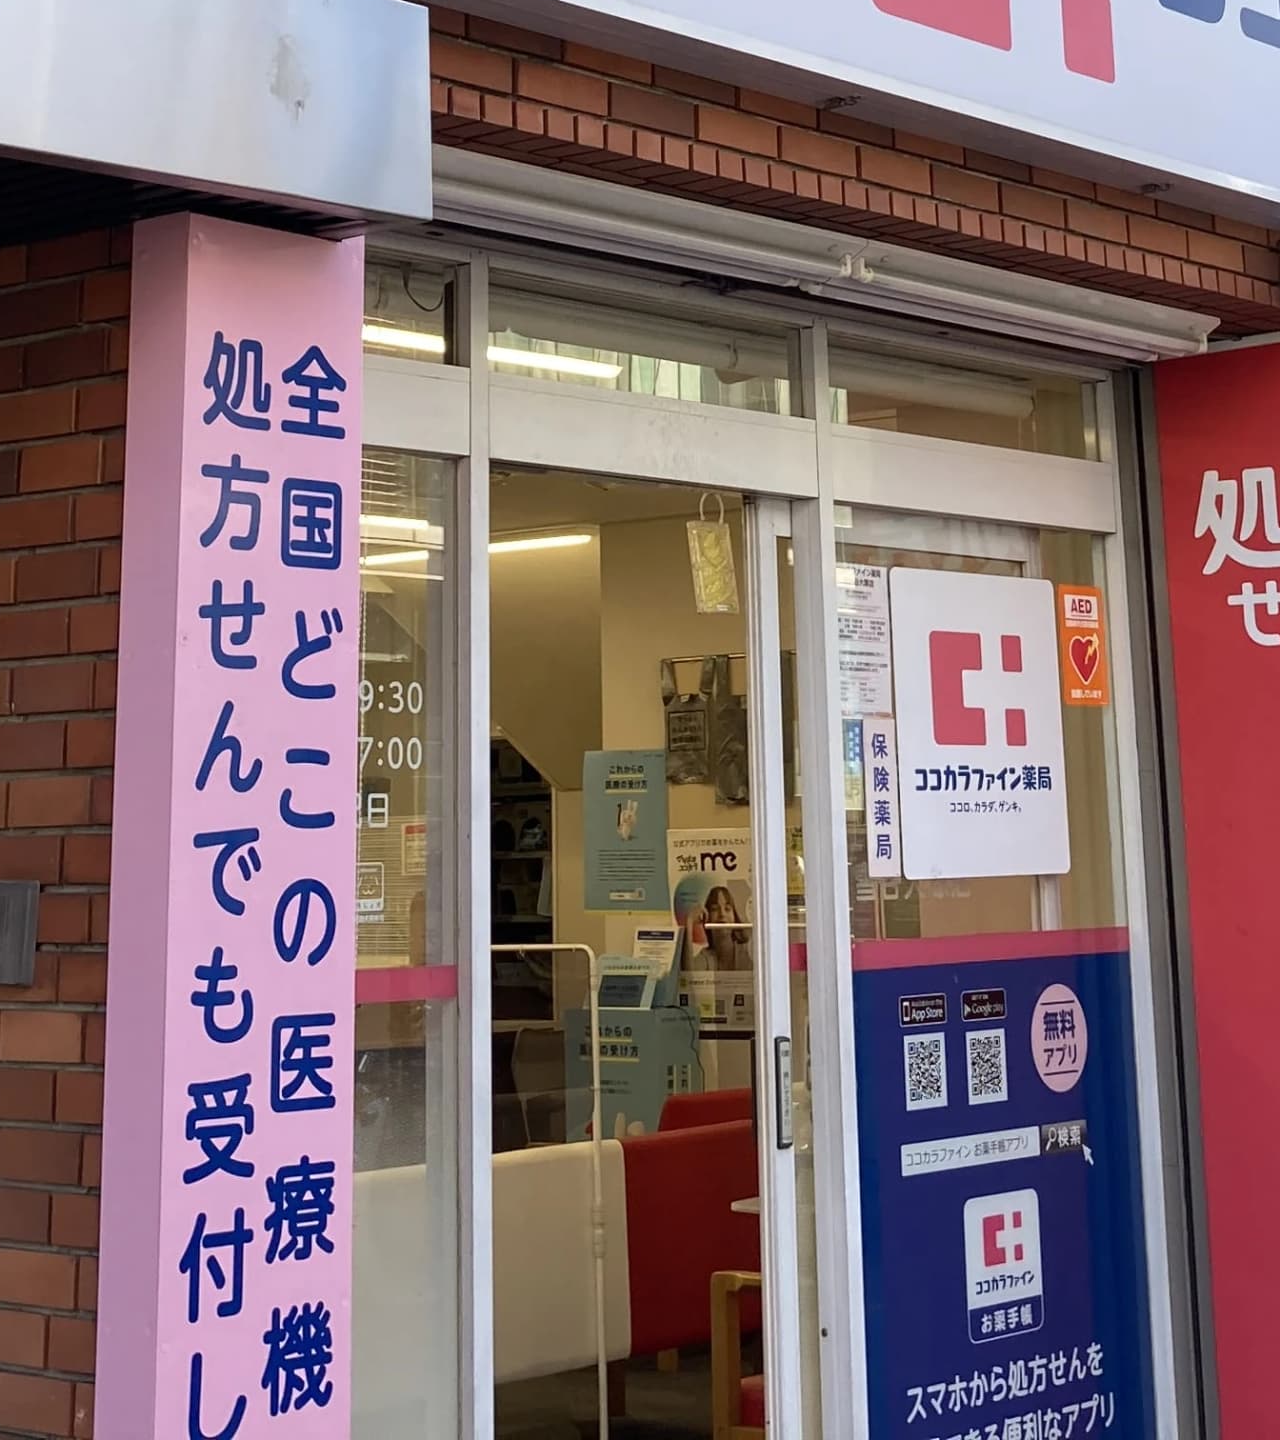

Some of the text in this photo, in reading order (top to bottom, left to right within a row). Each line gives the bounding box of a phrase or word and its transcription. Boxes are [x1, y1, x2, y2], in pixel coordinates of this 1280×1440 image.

[1070, 597, 1093, 615] AED
[914, 764, 1053, 792] ココカラファイン薬局
[870, 732, 893, 861] 保険薬局
[699, 851, 738, 872] me
[179, 330, 272, 1440] 処方せんでも受付し
[261, 344, 348, 1418] 全国どこの医療機
[1042, 1008, 1077, 1042] 無料
[1042, 1043, 1078, 1068] アプリ
[1056, 1124, 1082, 1148] 検索
[905, 1146, 971, 1169] ココカラファイン
[975, 1269, 1036, 1296] ココカラファイン
[980, 1302, 1034, 1335] お薬手帳
[905, 1341, 1105, 1425] スマホから処方せんを
